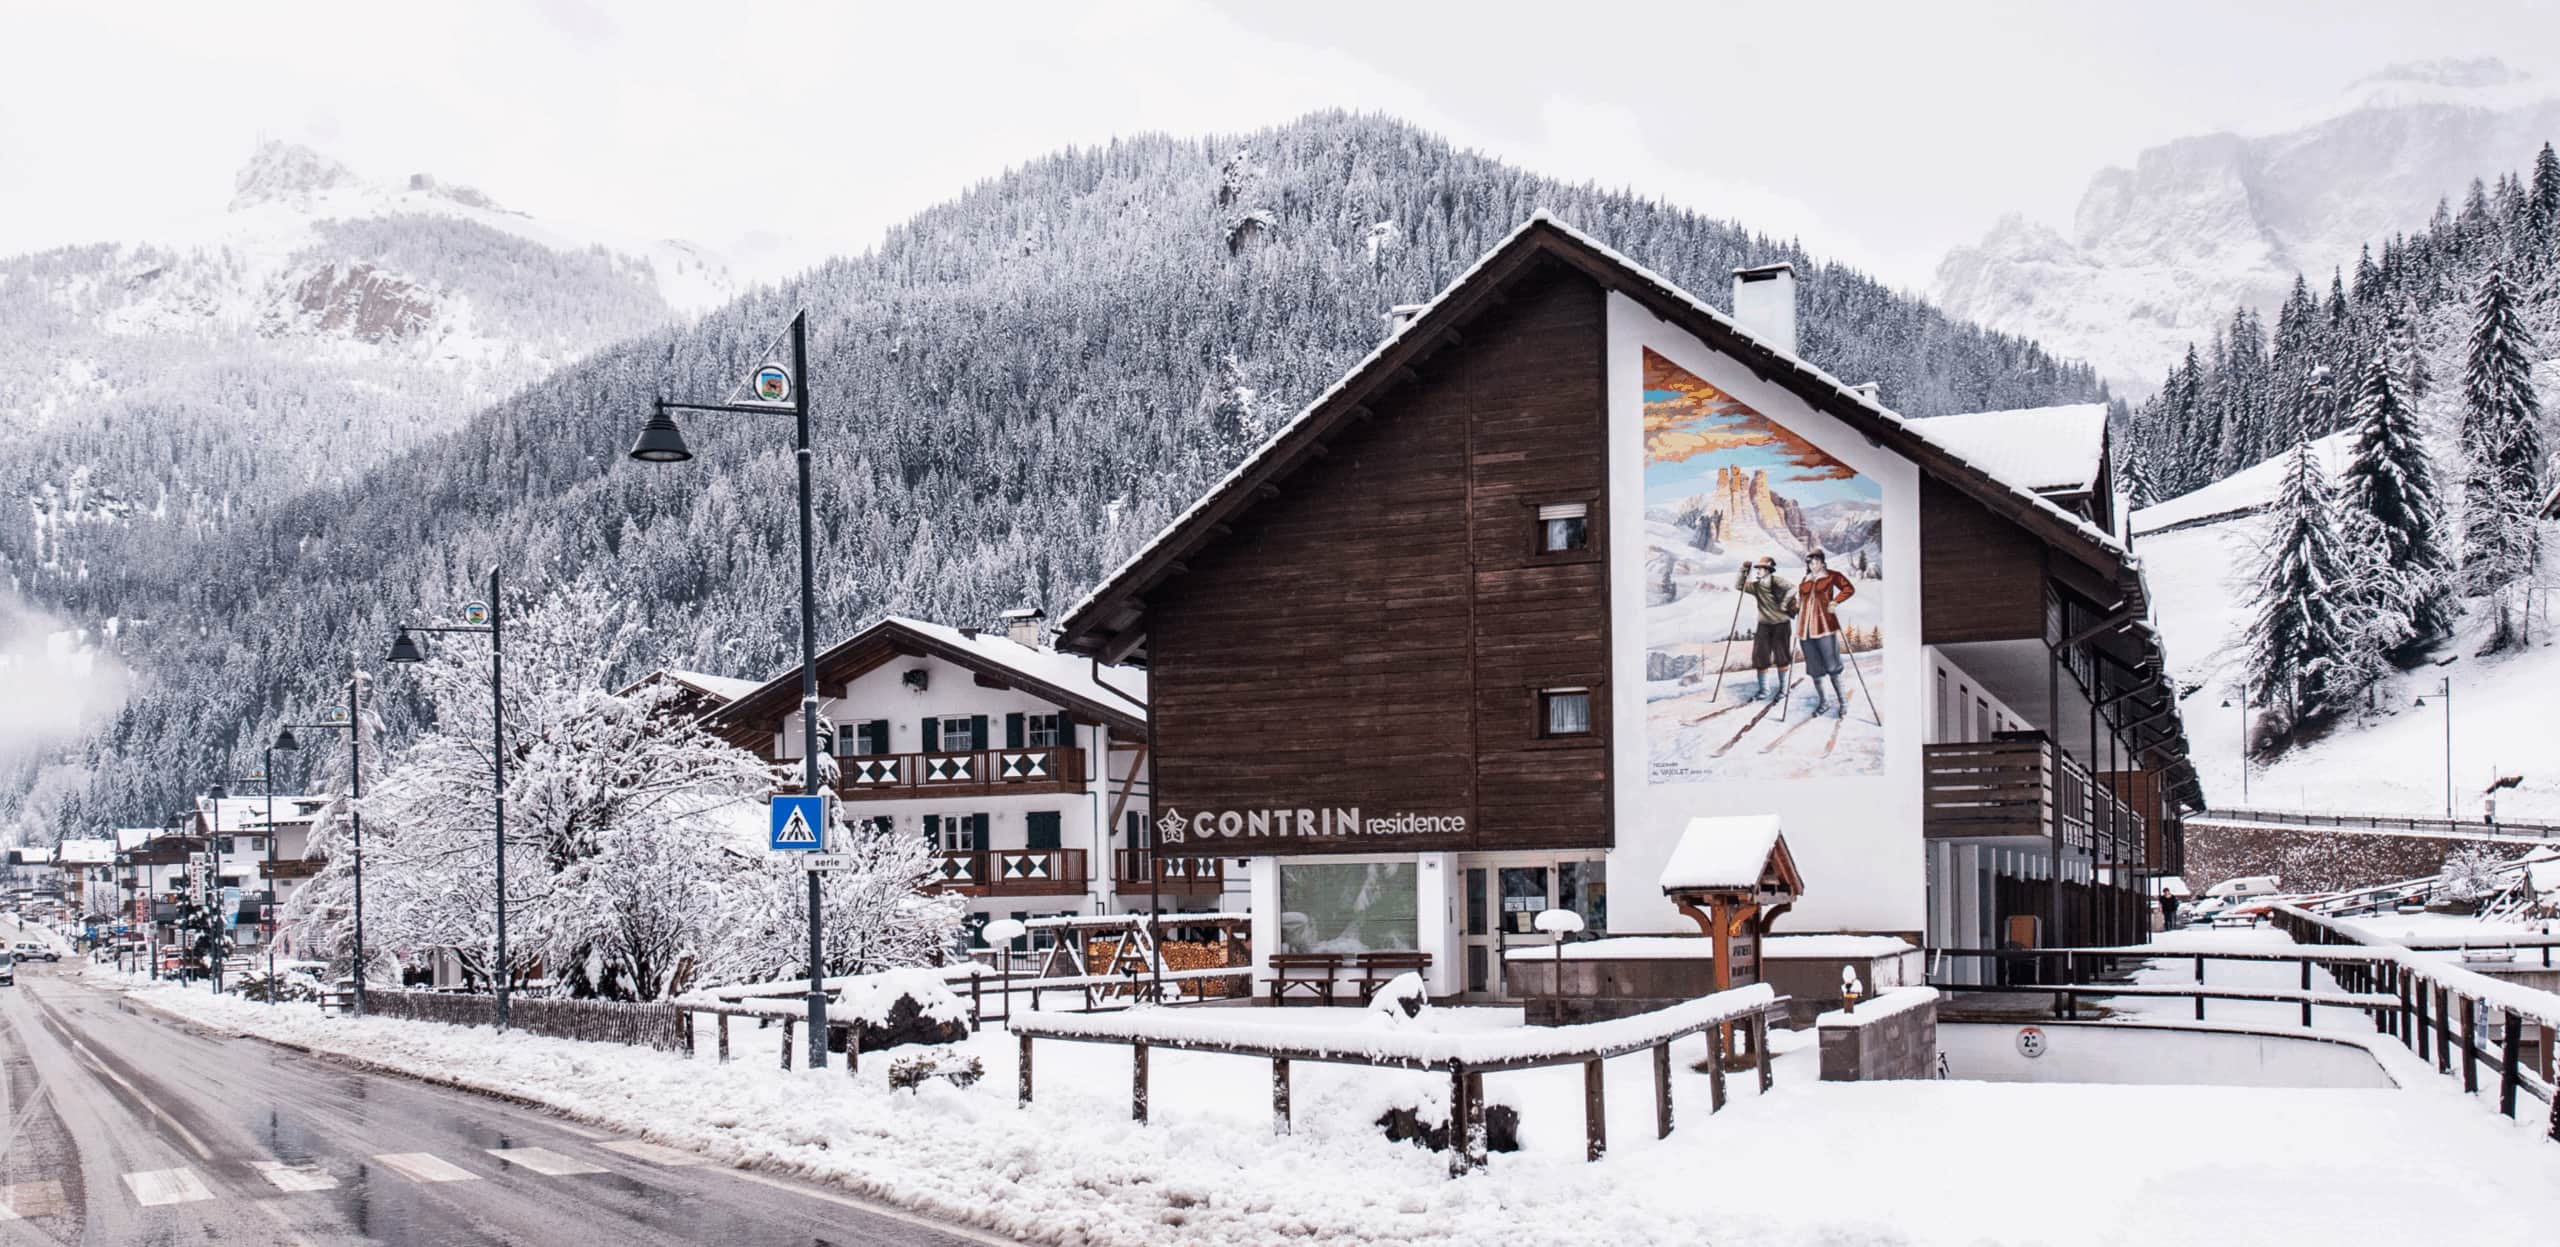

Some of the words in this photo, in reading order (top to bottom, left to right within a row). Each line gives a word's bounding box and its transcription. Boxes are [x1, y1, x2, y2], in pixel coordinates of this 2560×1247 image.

[1192, 807, 1360, 838] CONTRIN
[1366, 812, 1466, 835] residence
[814, 857, 840, 866] serie
